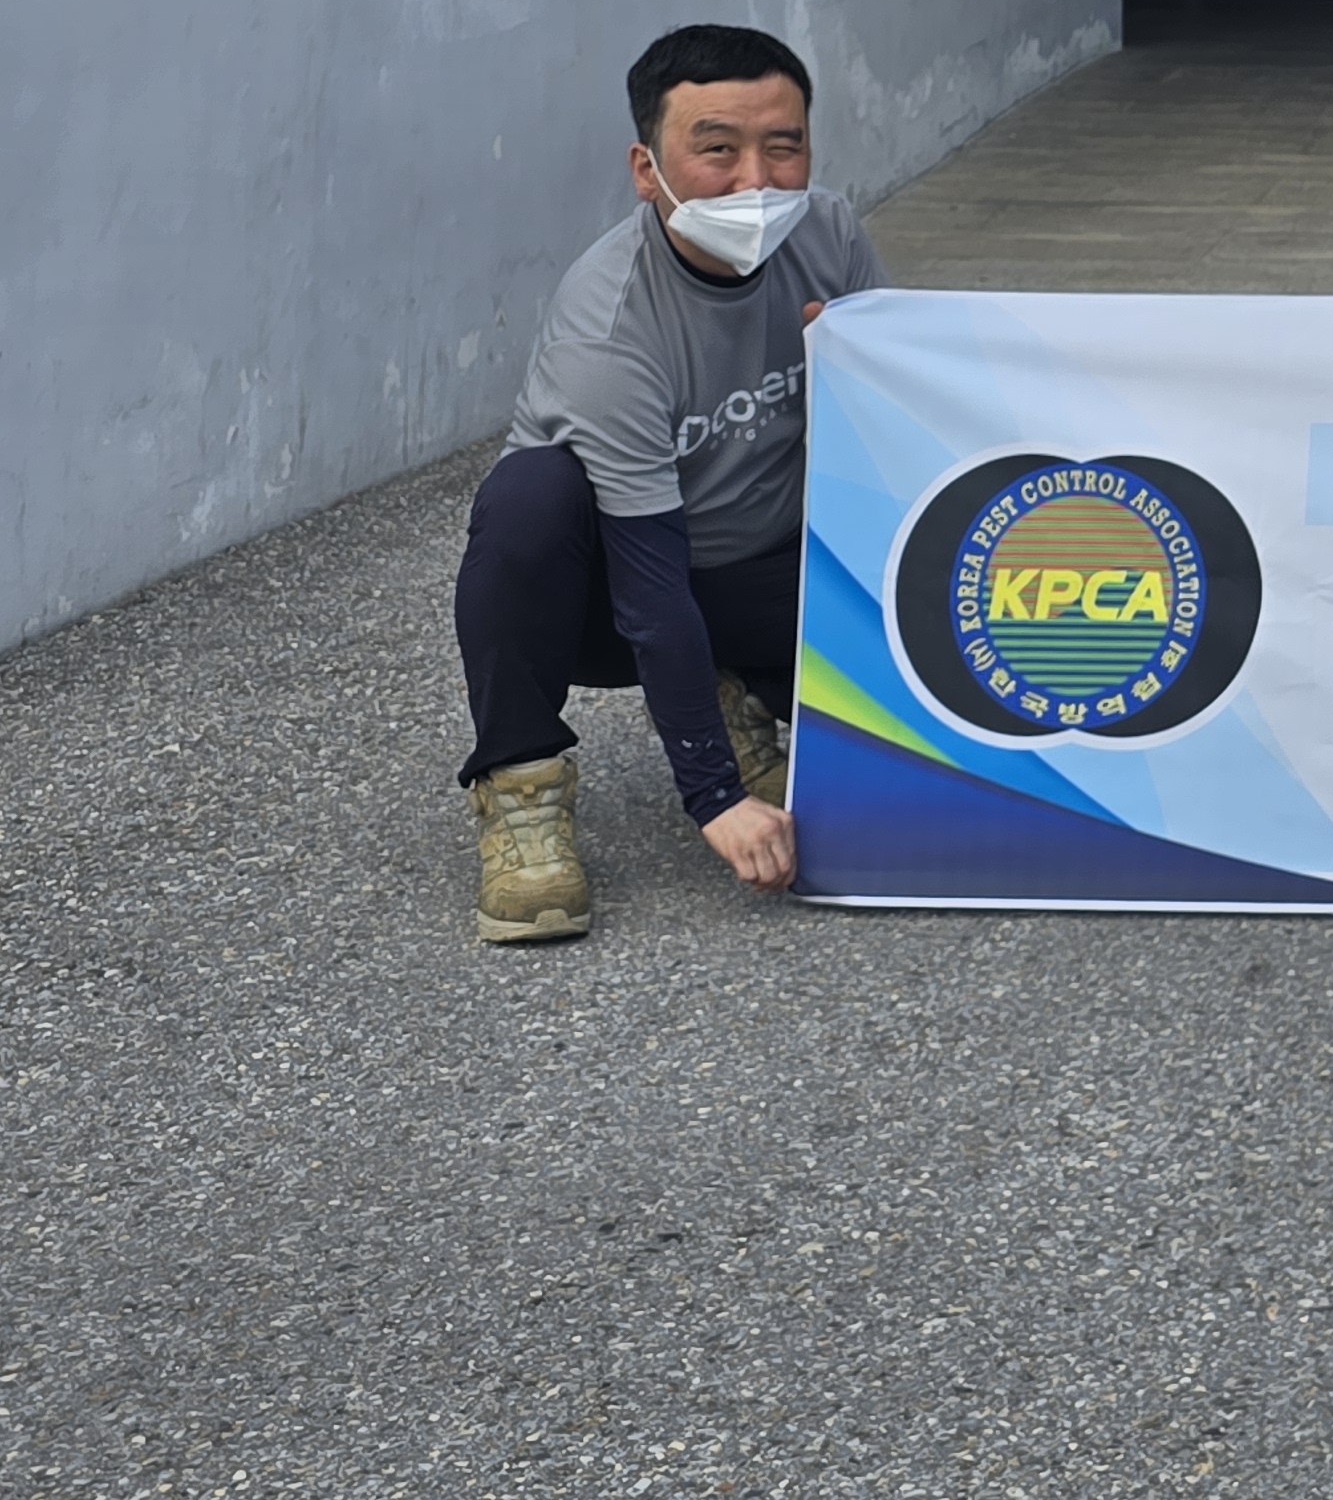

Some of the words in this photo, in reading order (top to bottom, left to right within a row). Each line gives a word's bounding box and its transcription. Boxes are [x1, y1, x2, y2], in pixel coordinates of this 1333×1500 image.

[957, 553, 985, 633] KOREA
[972, 495, 1018, 549] PEST
[1020, 470, 1127, 505] CONTROL
[1129, 488, 1200, 638] ASSOCIATION
[988, 568, 1169, 621] KPCA
